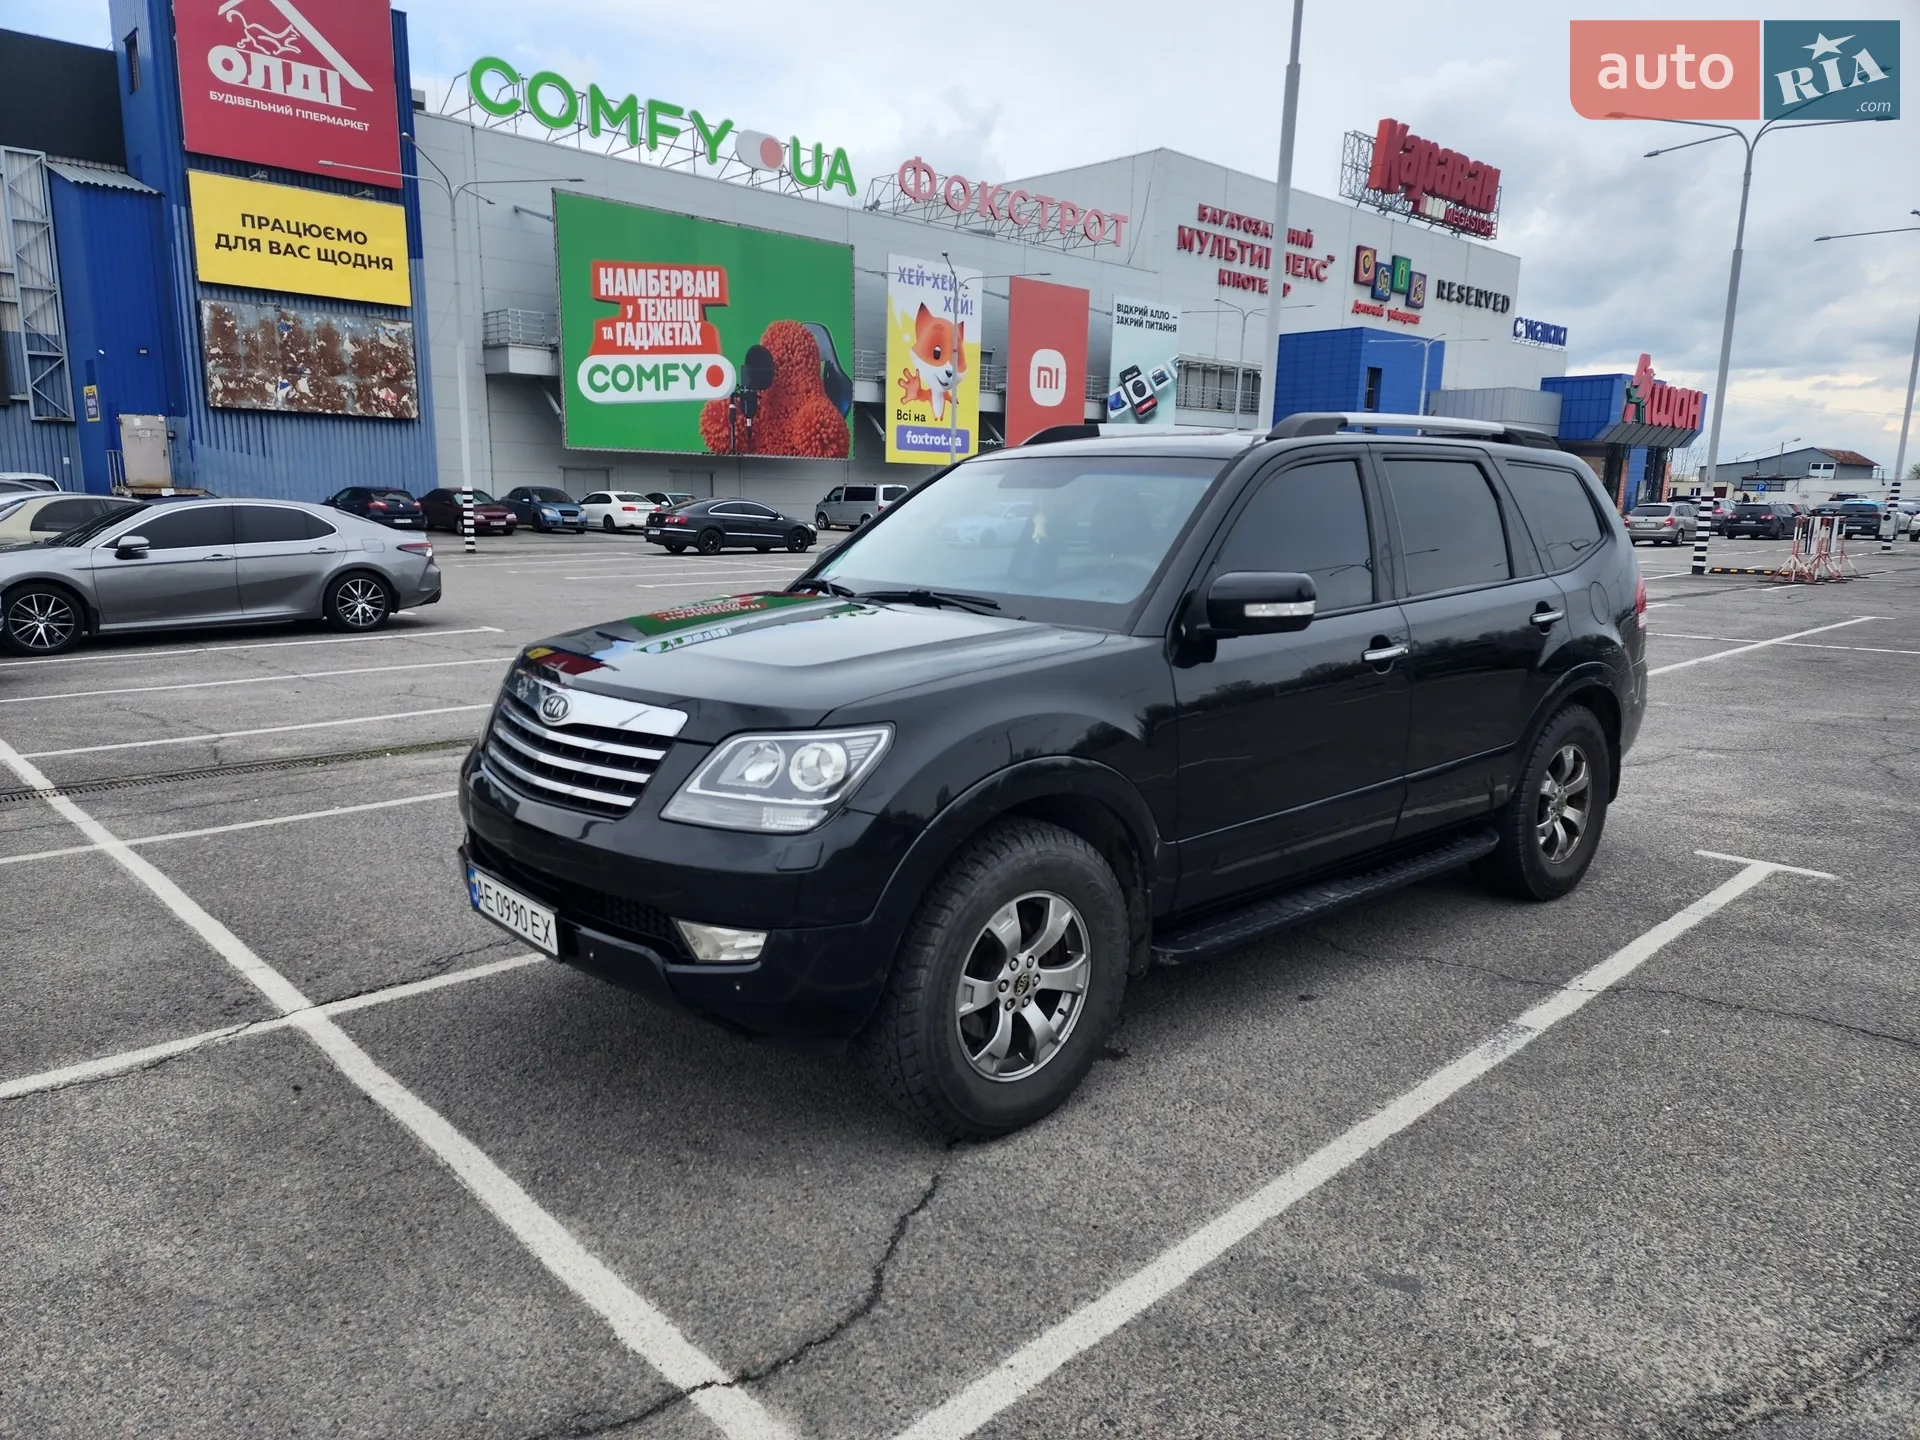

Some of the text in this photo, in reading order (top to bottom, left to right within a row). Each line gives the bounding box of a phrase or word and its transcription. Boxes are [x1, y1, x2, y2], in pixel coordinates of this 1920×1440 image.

[207, 45, 342, 106] ОЛДІ
[209, 90, 370, 132] БУДІВЕЛЬНИЙ ГІПЕРМАРКЕТ
[468, 55, 857, 197] COMFY UA
[1367, 118, 1501, 214] Караван
[897, 156, 1129, 248] ФОКСТРОТ
[240, 213, 368, 246] ПРАЦЮЄМО
[215, 233, 394, 272] ДЛЯ ВАС ЩОДНЯ
[599, 267, 720, 298] НАМБЕРВАН
[1436, 279, 1511, 314] RESERVED
[637, 298, 700, 322] ТЕХНІЦІ
[1116, 303, 1148, 317] ВІДКРИЙ
[1150, 309, 1170, 320] АЛЛО
[1116, 315, 1177, 333] ЗАКРИЙ ПИТАННЯ
[616, 322, 703, 350] ГАДЖЕТАХ
[587, 362, 703, 393] COMFY
[896, 409, 927, 422] Всі на
[478, 880, 553, 949] AE 0990 EX
